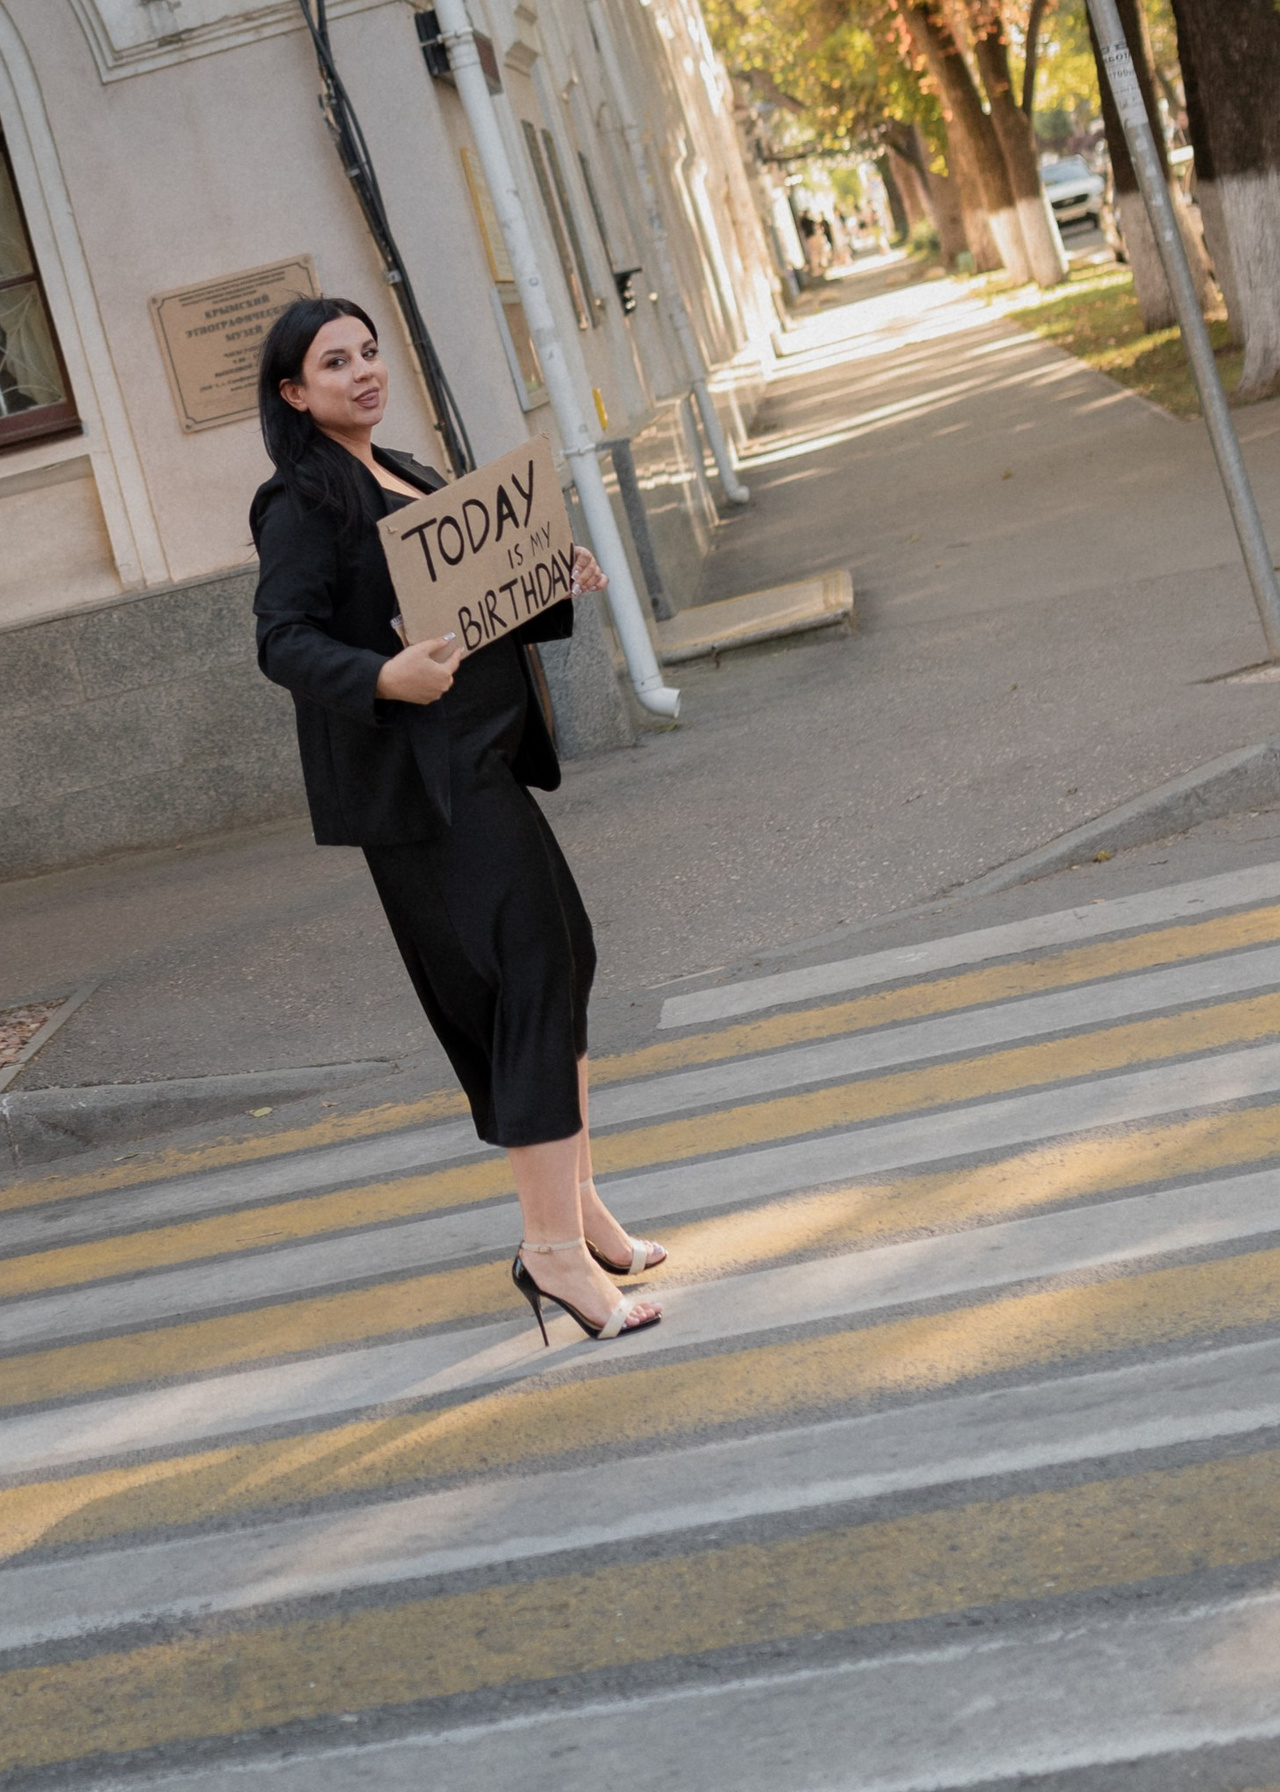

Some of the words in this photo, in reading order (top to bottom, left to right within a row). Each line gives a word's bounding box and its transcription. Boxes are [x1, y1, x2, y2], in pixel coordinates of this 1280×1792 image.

[185, 306, 284, 339] ЭТНОГРАФИЧЕСК
[204, 293, 270, 319] КРЫМСКИЙ
[225, 324, 263, 342] МУЗЕЙ
[401, 460, 534, 582] TODAY
[507, 543, 524, 569] IS
[529, 521, 551, 556] MY
[458, 541, 575, 651] BIRTHDAY
